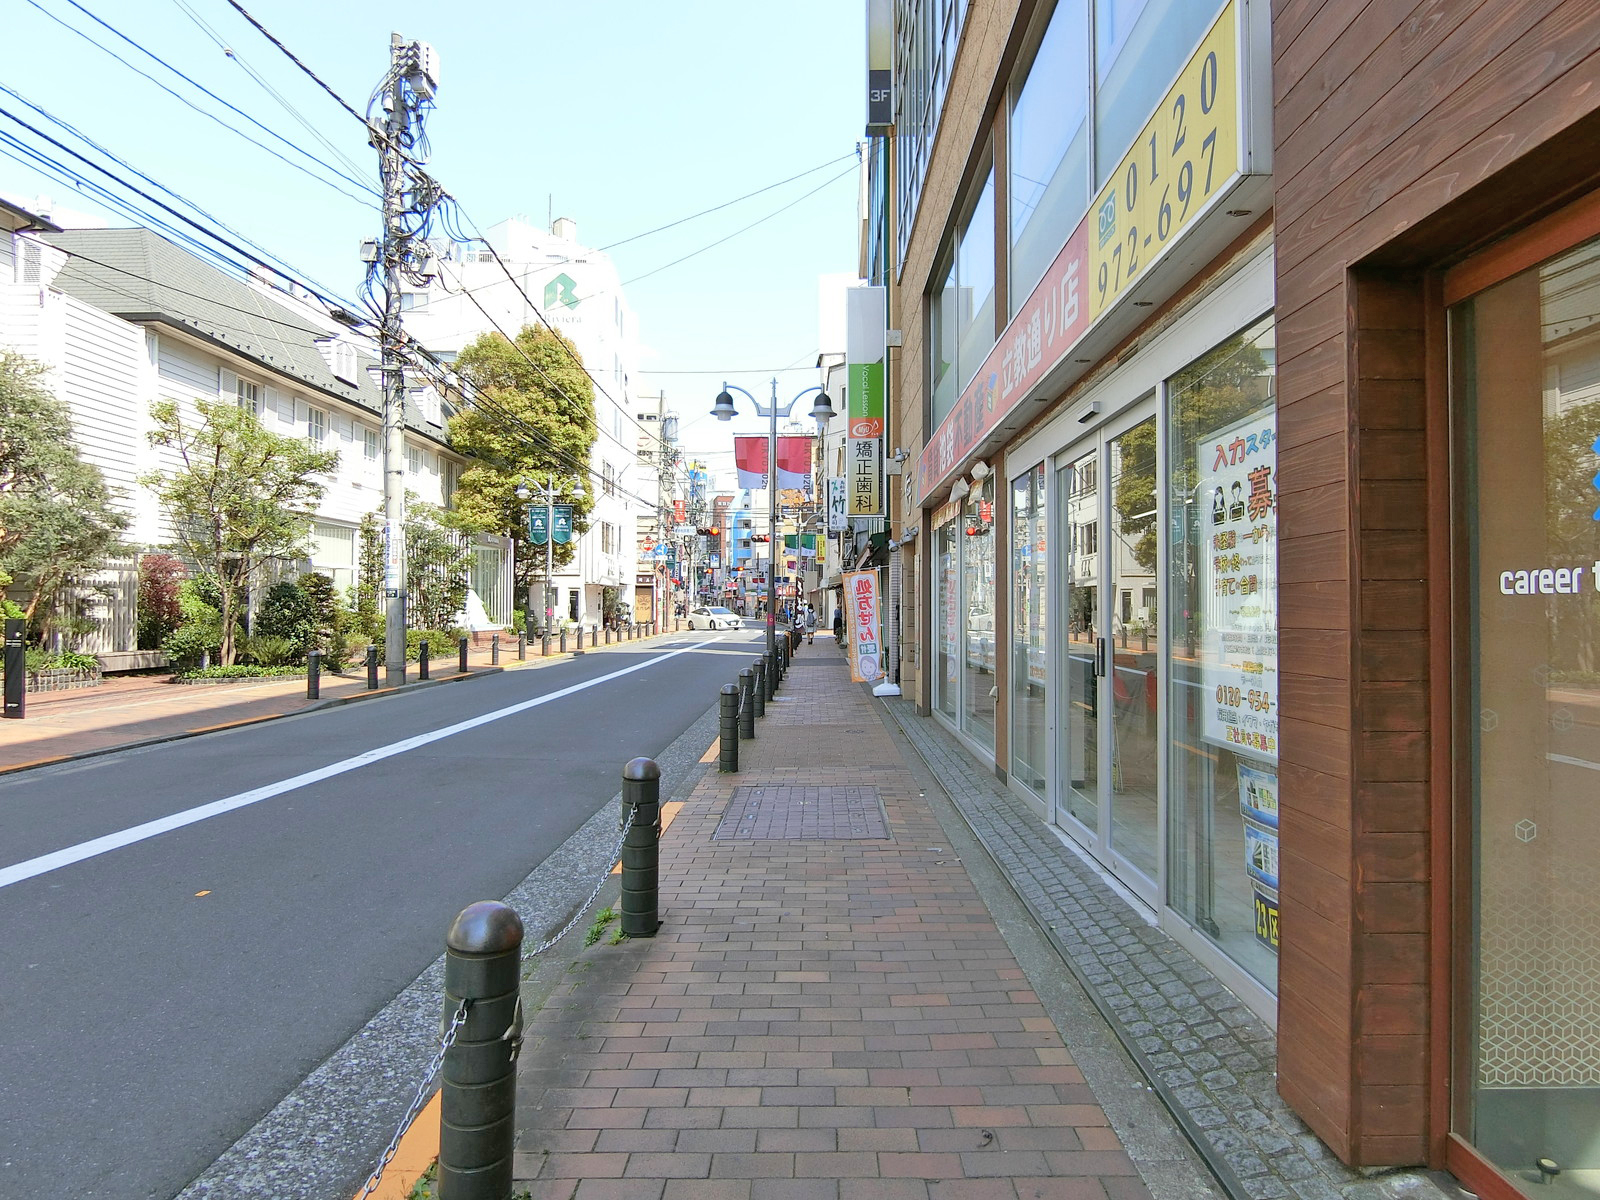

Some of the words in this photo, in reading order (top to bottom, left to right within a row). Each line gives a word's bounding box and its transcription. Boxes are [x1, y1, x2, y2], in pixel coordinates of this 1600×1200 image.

[870, 89, 891, 102] 3F
[1126, 51, 1217, 213] 0120
[1098, 126, 1217, 309] 972-697
[1001, 258, 1080, 400] 立教通り店
[832, 495, 846, 514] 竹
[855, 440, 873, 512] 矯正歯科
[1247, 465, 1277, 521] 募
[1500, 567, 1583, 595] career
